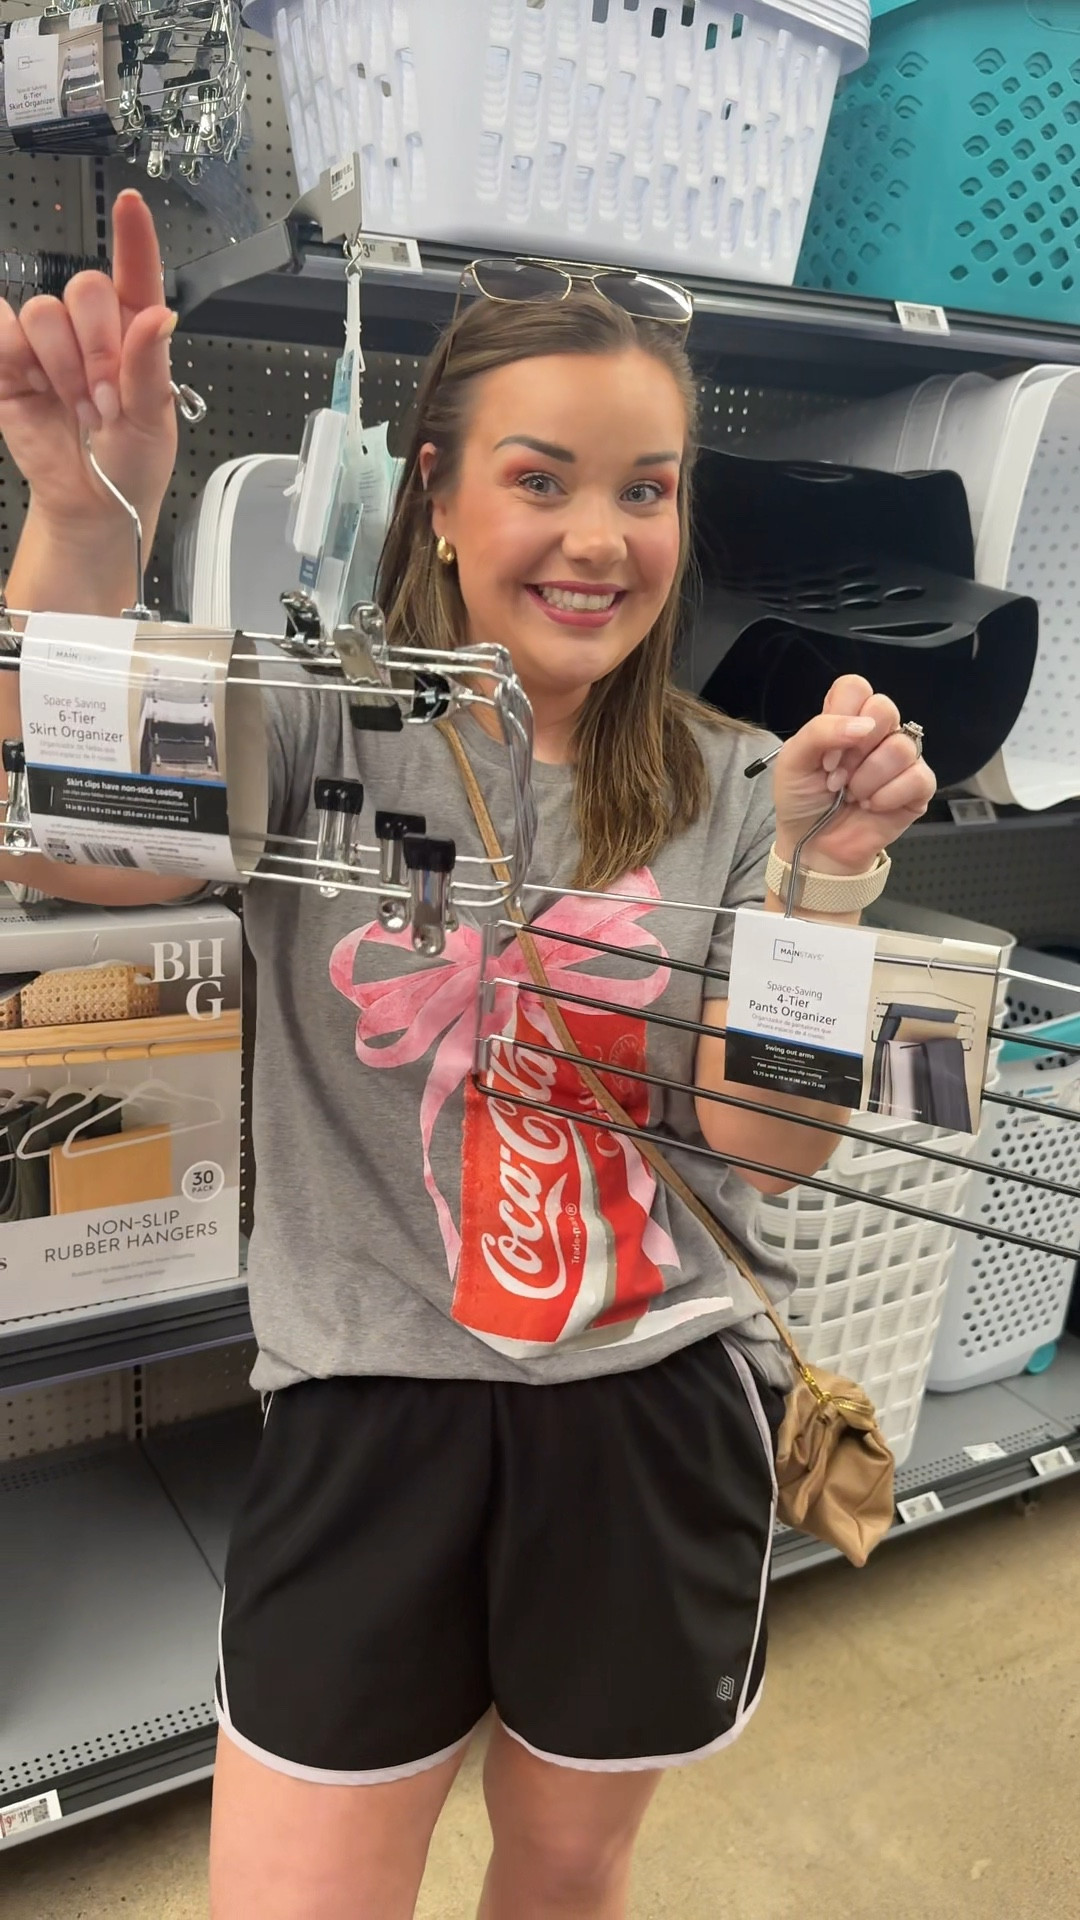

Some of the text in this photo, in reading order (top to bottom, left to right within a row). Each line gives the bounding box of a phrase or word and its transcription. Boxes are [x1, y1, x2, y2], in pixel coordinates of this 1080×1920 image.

[24, 98, 56, 108] Organizer
[44, 694, 106, 712] Space Saving
[59, 710, 96, 725] 6-Tier
[29, 722, 123, 742] Skirt Organizer
[66, 778, 83, 786] Skirt
[84, 780, 100, 789] clips
[102, 782, 119, 791] have
[121, 785, 153, 794] non-stick
[155, 788, 183, 799] coating
[150, 937, 226, 983] BH
[767, 980, 823, 1000] Space-Saving
[185, 980, 225, 1021] G
[777, 994, 810, 1008] 4-Tier
[749, 1000, 837, 1026] Pants Organizer
[765, 1044, 785, 1054] Swing
[799, 1052, 814, 1060] arms
[192, 1170, 214, 1186] 30
[481, 1038, 568, 1299] Coca-Cola
[192, 1185, 213, 1193] PACK
[87, 1210, 180, 1237] NON-SLIP
[45, 1221, 218, 1263] RUBBER HANGERS
